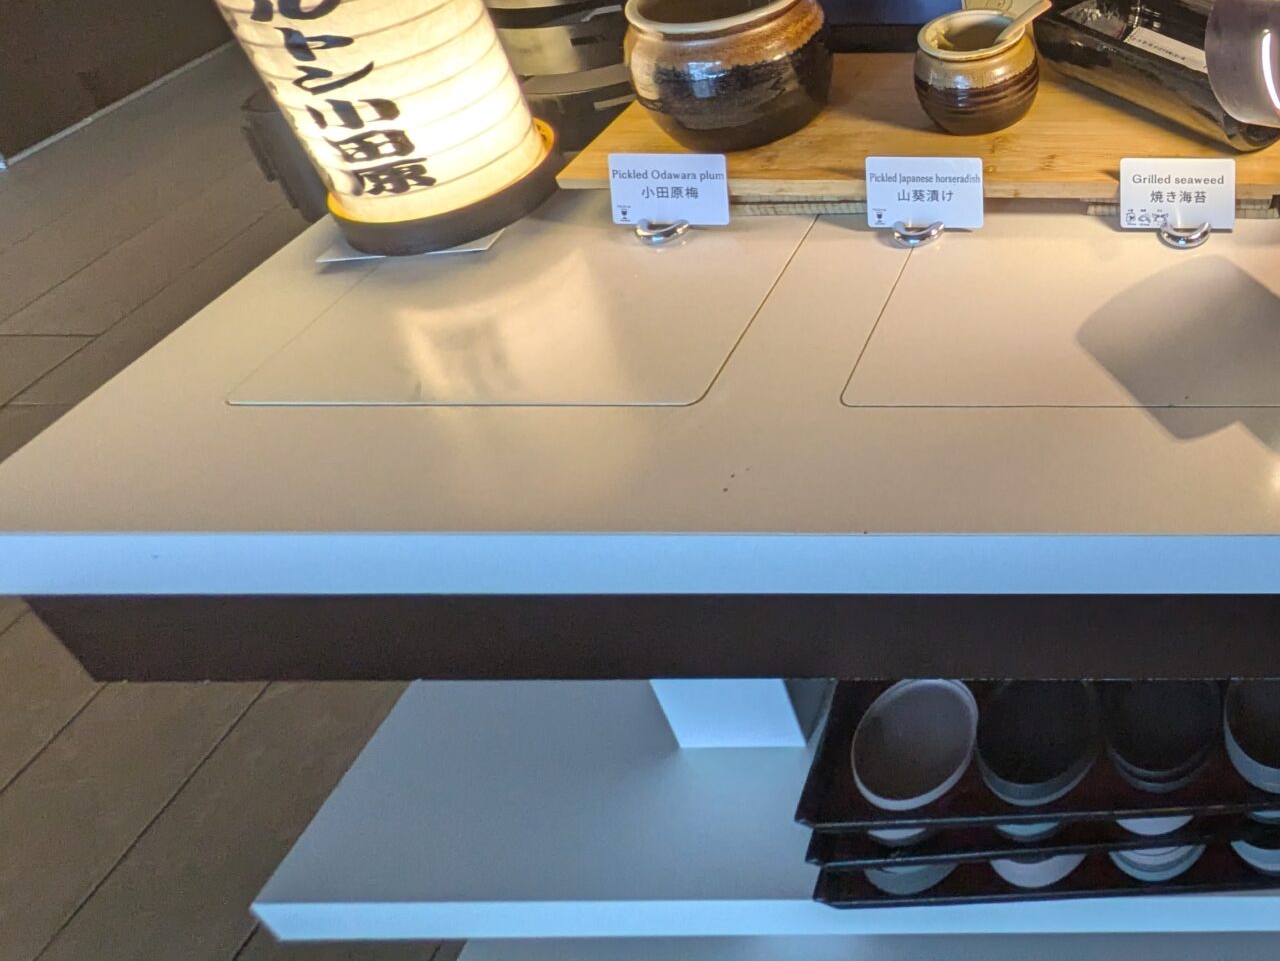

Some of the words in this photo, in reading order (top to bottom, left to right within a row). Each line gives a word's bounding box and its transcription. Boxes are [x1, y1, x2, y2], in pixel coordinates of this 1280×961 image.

[611, 169, 648, 180] Pickled
[650, 169, 697, 180] Odawara
[699, 170, 724, 182] plum
[869, 172, 897, 183] Pickled
[899, 173, 934, 185] Japanese
[935, 173, 981, 184] horseradish
[1132, 174, 1171, 185] Grilled
[1174, 175, 1225, 185] seaweed
[641, 186, 699, 199] 小田原梅
[897, 189, 954, 202] 山葵漬け
[1150, 190, 1207, 204] 焼き海苔
